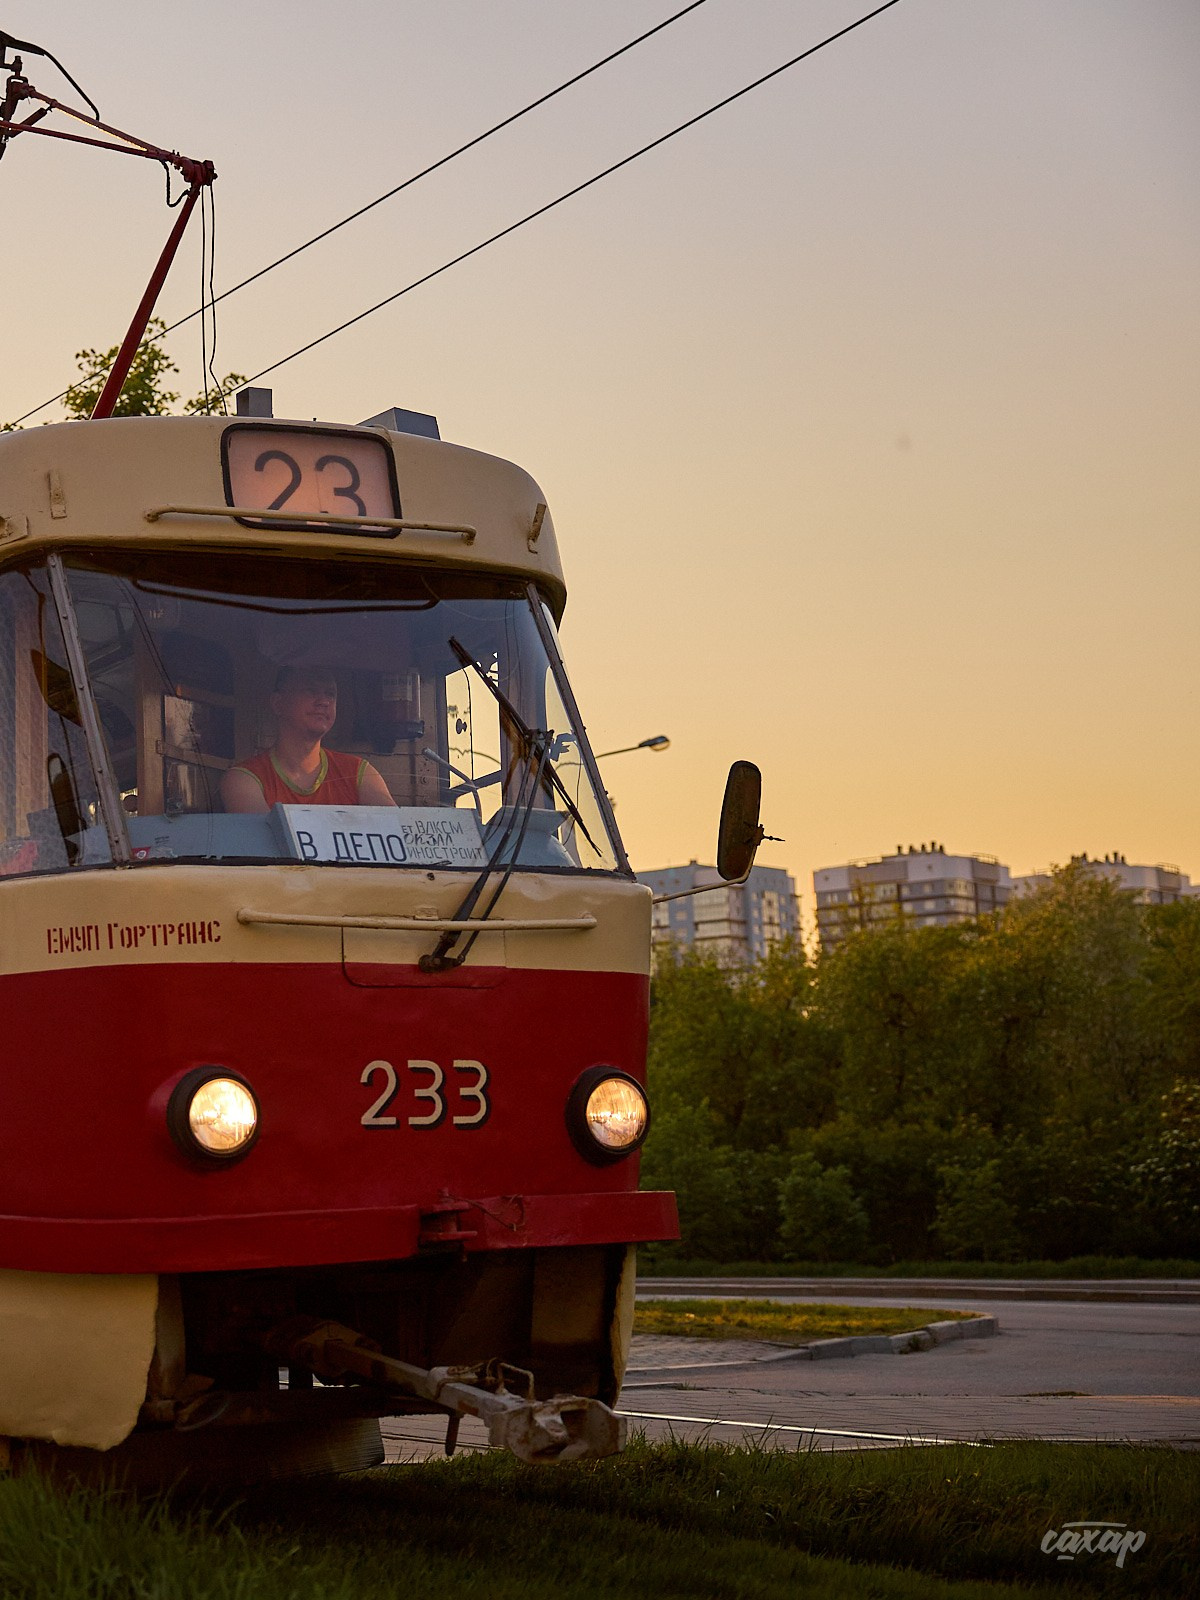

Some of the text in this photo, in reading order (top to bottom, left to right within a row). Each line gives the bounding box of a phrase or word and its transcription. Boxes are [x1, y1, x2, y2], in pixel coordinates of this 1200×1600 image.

[254, 449, 367, 529] 23
[296, 831, 408, 862] В ДЕПО
[46, 924, 100, 954] ЕМУП
[359, 1059, 490, 1128] 233
